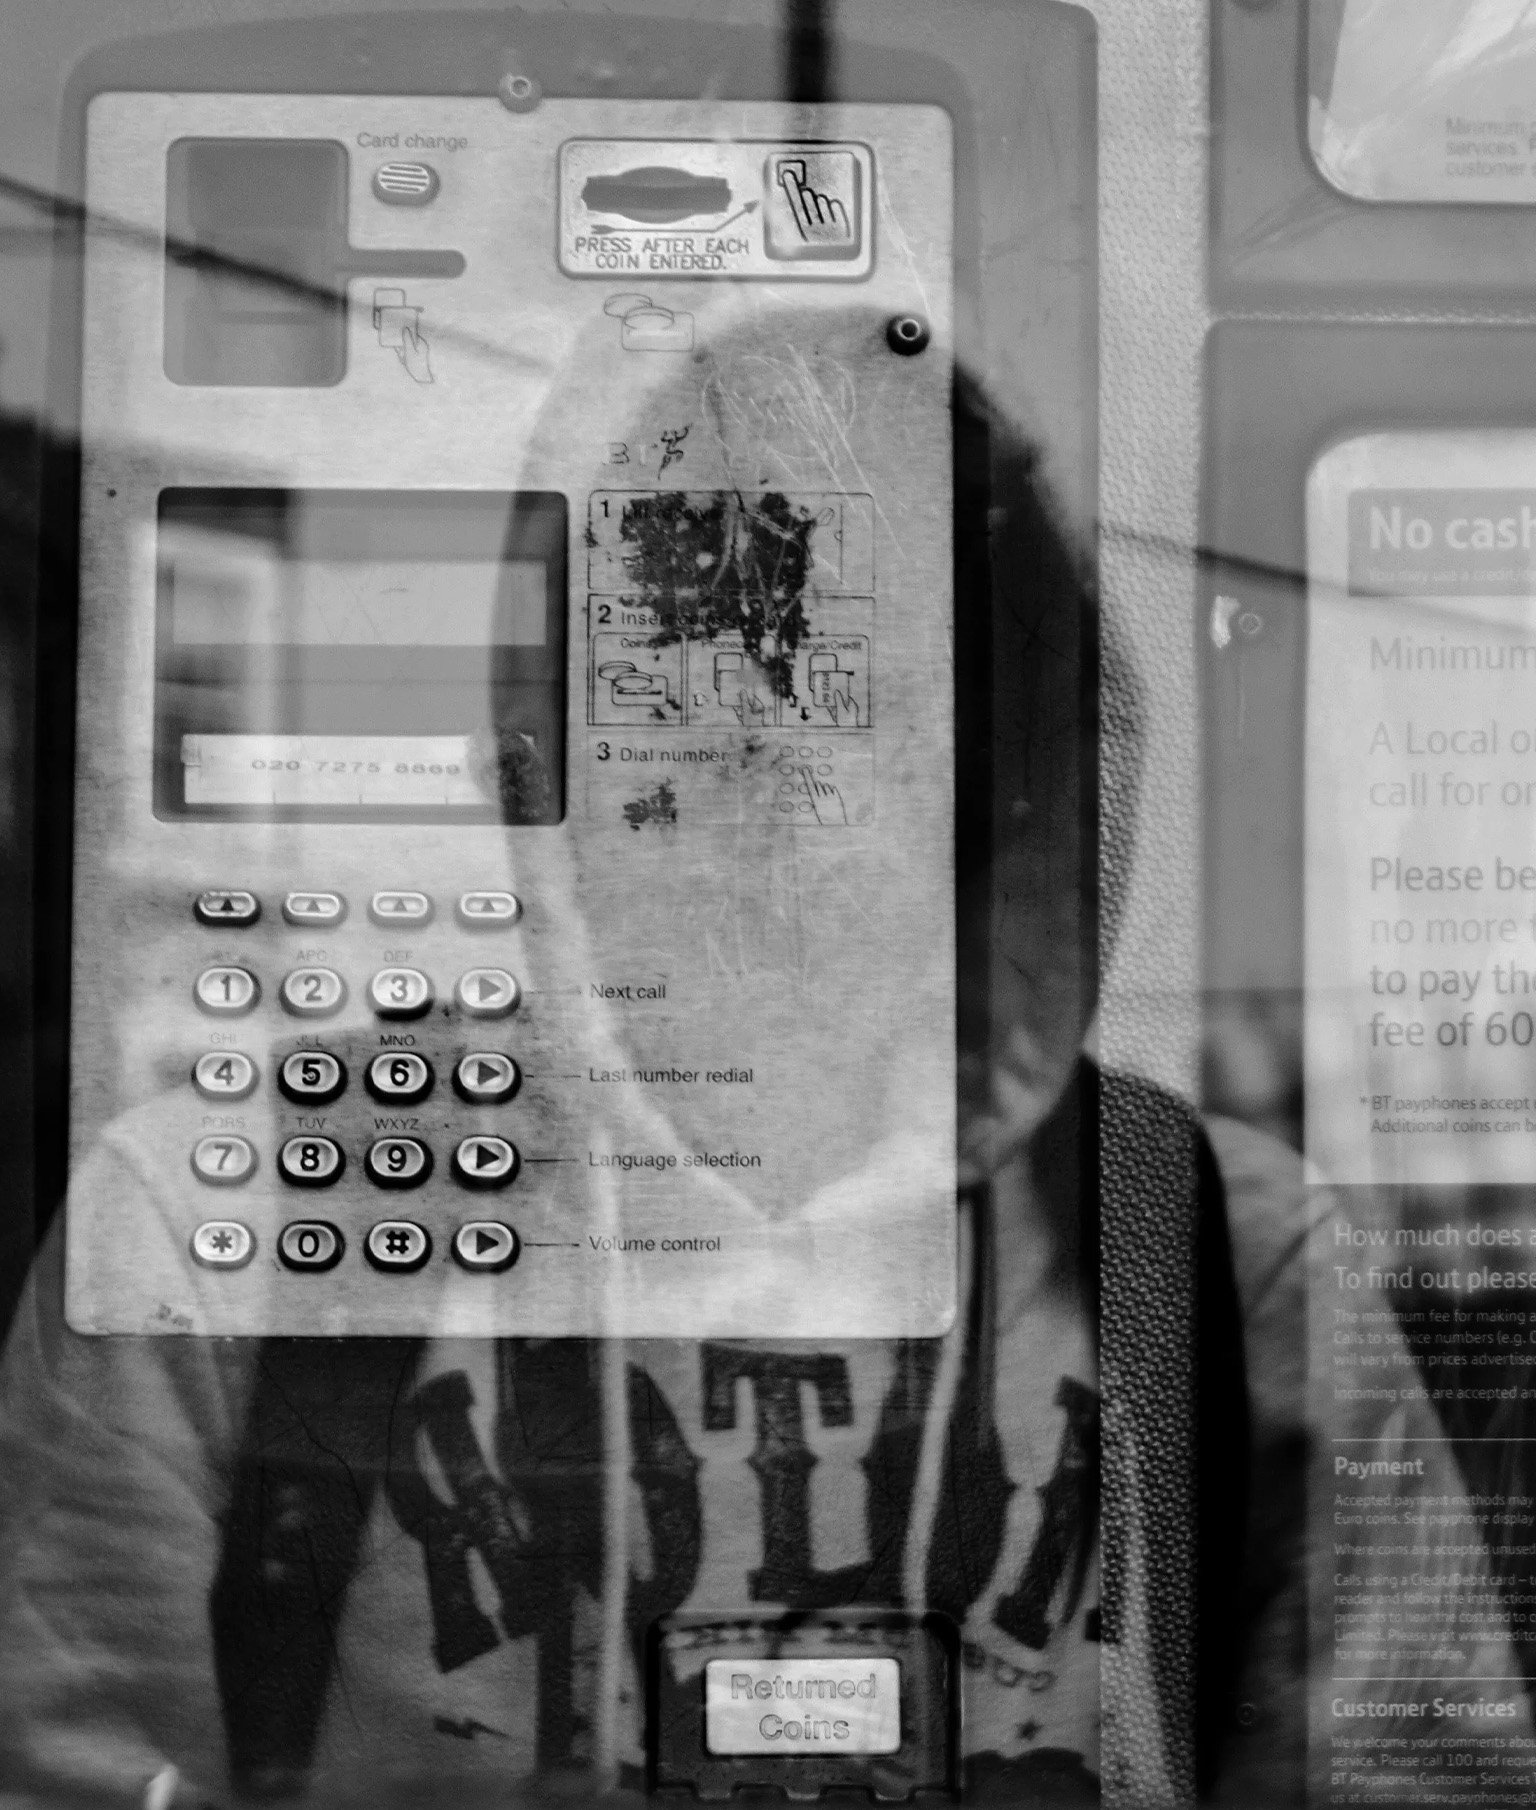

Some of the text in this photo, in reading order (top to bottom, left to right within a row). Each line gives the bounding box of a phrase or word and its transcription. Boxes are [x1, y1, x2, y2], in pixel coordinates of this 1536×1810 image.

[356, 133, 468, 153] Card change
[575, 237, 750, 255] PRESS AFTER EACH
[596, 254, 727, 270] COIN ENTERED.
[599, 500, 610, 518] 1
[1370, 506, 1433, 550] No
[597, 604, 612, 625] 2
[1370, 636, 1536, 671] Minimum
[1369, 719, 1498, 755] A Local
[597, 741, 728, 763] 3 Dial number
[251, 759, 301, 771] 020
[1369, 771, 1491, 807] call for
[1370, 856, 1536, 892] Please be
[1370, 918, 1415, 944] no
[1425, 918, 1518, 944] more
[383, 950, 414, 963] DEF
[220, 974, 231, 1001] 1
[303, 974, 323, 1001] 2
[389, 974, 409, 1002] 3
[591, 983, 667, 999] Next call
[1369, 960, 1536, 1002] to pay th
[1370, 1011, 1535, 1047] fee of 60
[379, 1034, 416, 1047] MNO
[213, 1059, 235, 1086] 4
[300, 1058, 322, 1087] 5
[389, 1058, 410, 1087] 6
[589, 1068, 754, 1083] Last number redial
[1395, 1095, 1477, 1113] payphones
[1480, 1097, 1531, 1112] accept
[296, 1116, 327, 1129] TUV
[374, 1117, 420, 1131] WXYZ
[1370, 1117, 1521, 1133] Additional coins can
[214, 1143, 233, 1171] 7
[300, 1143, 320, 1172] 8
[387, 1144, 407, 1172] 9
[589, 1152, 762, 1170] Language selection
[298, 1230, 320, 1258] 0
[589, 1236, 722, 1251] Volume control
[1334, 1222, 1522, 1246] How much does
[1333, 1265, 1536, 1293] To find out please
[1333, 1308, 1526, 1325] The minimum fee for making
[1333, 1330, 1527, 1347] Calls to service numbers (e.g.
[1333, 1352, 1357, 1366] will
[1360, 1354, 1389, 1369] vary
[1392, 1351, 1425, 1366] from
[1428, 1352, 1468, 1367] prices
[1334, 1385, 1398, 1402] Incoming
[1400, 1385, 1430, 1400] calls
[1432, 1388, 1453, 1400] are
[1456, 1385, 1518, 1402] accepted
[1334, 1456, 1425, 1480] Payment
[1333, 1493, 1391, 1508] Accepted
[1508, 1496, 1534, 1508] may
[1334, 1511, 1363, 1525] Euro
[1404, 1511, 1427, 1525] See
[1429, 1512, 1490, 1527] payphone
[1492, 1511, 1535, 1527] display
[1333, 1543, 1374, 1556] Where
[1334, 1573, 1363, 1586] Calls
[1365, 1574, 1398, 1589] using
[1400, 1575, 1409, 1586] a
[1489, 1573, 1516, 1587] card
[1459, 1613, 1485, 1624] cost
[1487, 1611, 1511, 1624] and
[1512, 1613, 1527, 1624] to
[730, 1673, 877, 1701] Returned
[1331, 1697, 1517, 1718] Customer Services
[758, 1713, 851, 1741] Coins
[1331, 1736, 1350, 1748] We
[1353, 1735, 1408, 1748] welcome
[1411, 1737, 1439, 1750] your
[1441, 1736, 1507, 1748] comments
[1331, 1754, 1378, 1767] service.
[1380, 1753, 1420, 1767] Please
[1422, 1753, 1443, 1767] call
[1446, 1753, 1473, 1767] 100
[1475, 1753, 1499, 1767] and
[1331, 1772, 1347, 1785] BT
[1350, 1772, 1418, 1788] Payphones
[1419, 1771, 1478, 1786] Customer
[1480, 1771, 1531, 1786] Services
[1330, 1792, 1361, 1804] us at
